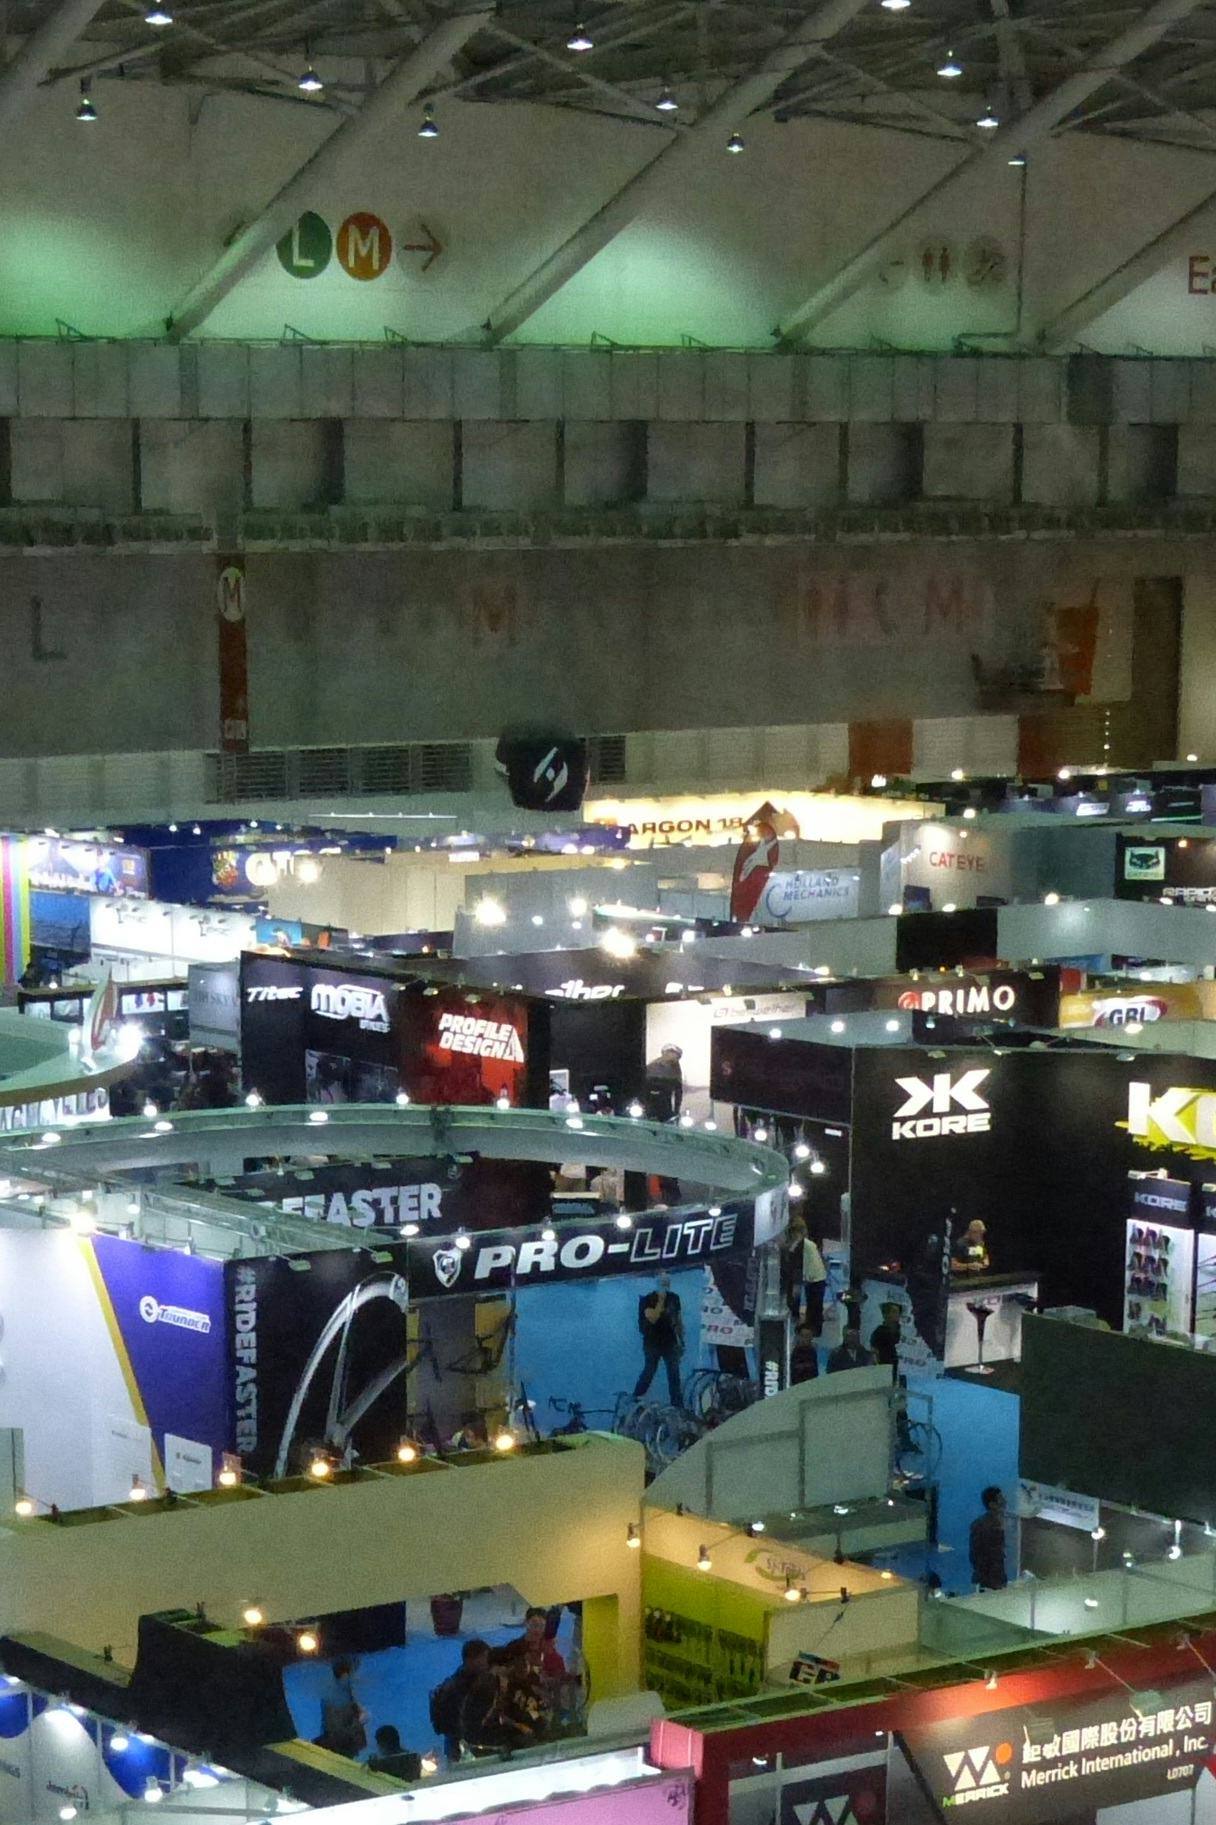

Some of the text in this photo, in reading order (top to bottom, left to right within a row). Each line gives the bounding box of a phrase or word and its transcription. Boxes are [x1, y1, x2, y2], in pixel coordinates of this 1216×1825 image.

[291, 224, 380, 270] L M
[222, 575, 243, 612] M
[627, 819, 711, 836] ARGON
[929, 850, 986, 871] CATEYE
[783, 885, 850, 902] MECHANICS
[921, 984, 1016, 1016] PRIMO
[438, 1012, 513, 1042] PROFILE
[439, 1031, 512, 1061] DESIGN
[891, 1112, 992, 1141] KORE
[260, 1182, 443, 1229] EFASTER
[1133, 1190, 1188, 1213] KORE
[473, 1213, 738, 1281] PRO-LITE
[1020, 1760, 1078, 1790] Merrick
[942, 1782, 1010, 1808] MERRICK
